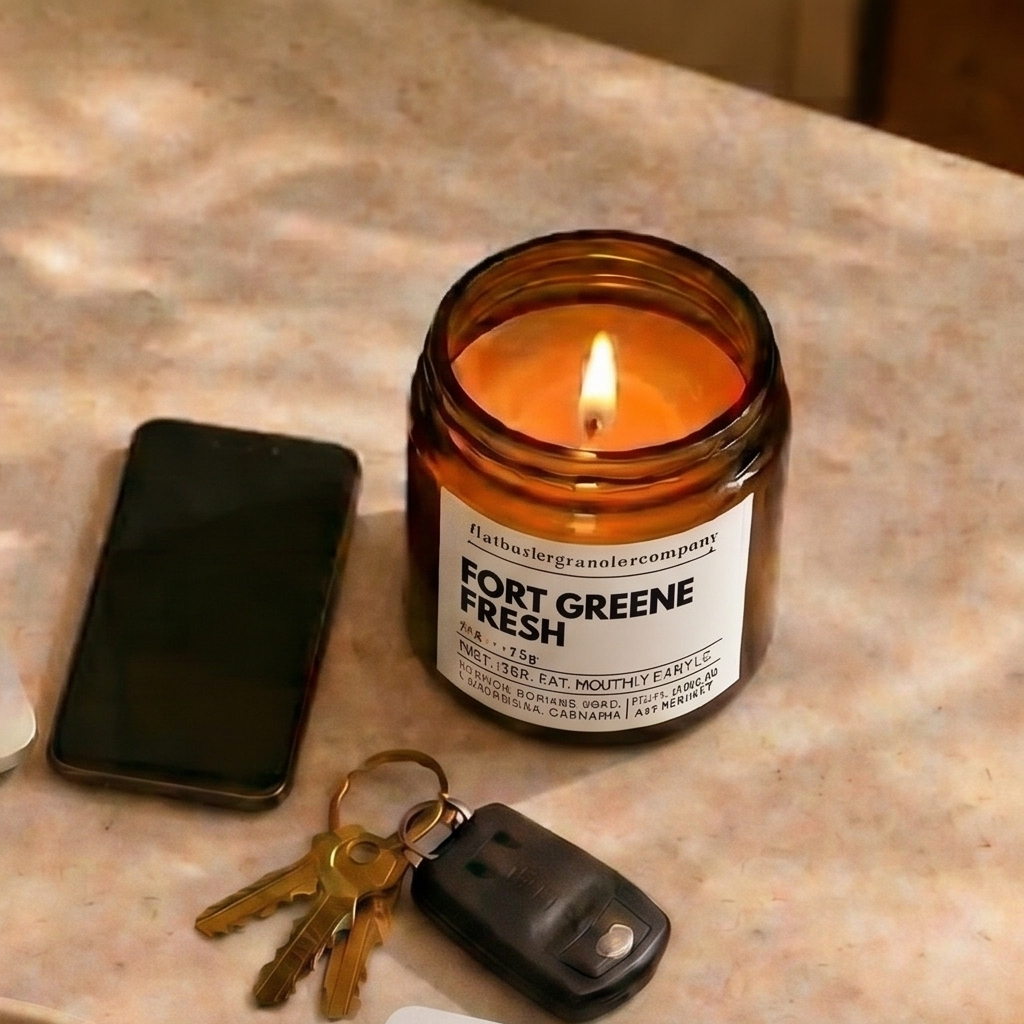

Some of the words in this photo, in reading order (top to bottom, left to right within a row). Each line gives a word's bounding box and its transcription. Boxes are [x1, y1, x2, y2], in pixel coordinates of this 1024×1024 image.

[461, 556, 548, 613] FORT
[556, 577, 694, 620] GREENE
[461, 585, 566, 647] FRESH
